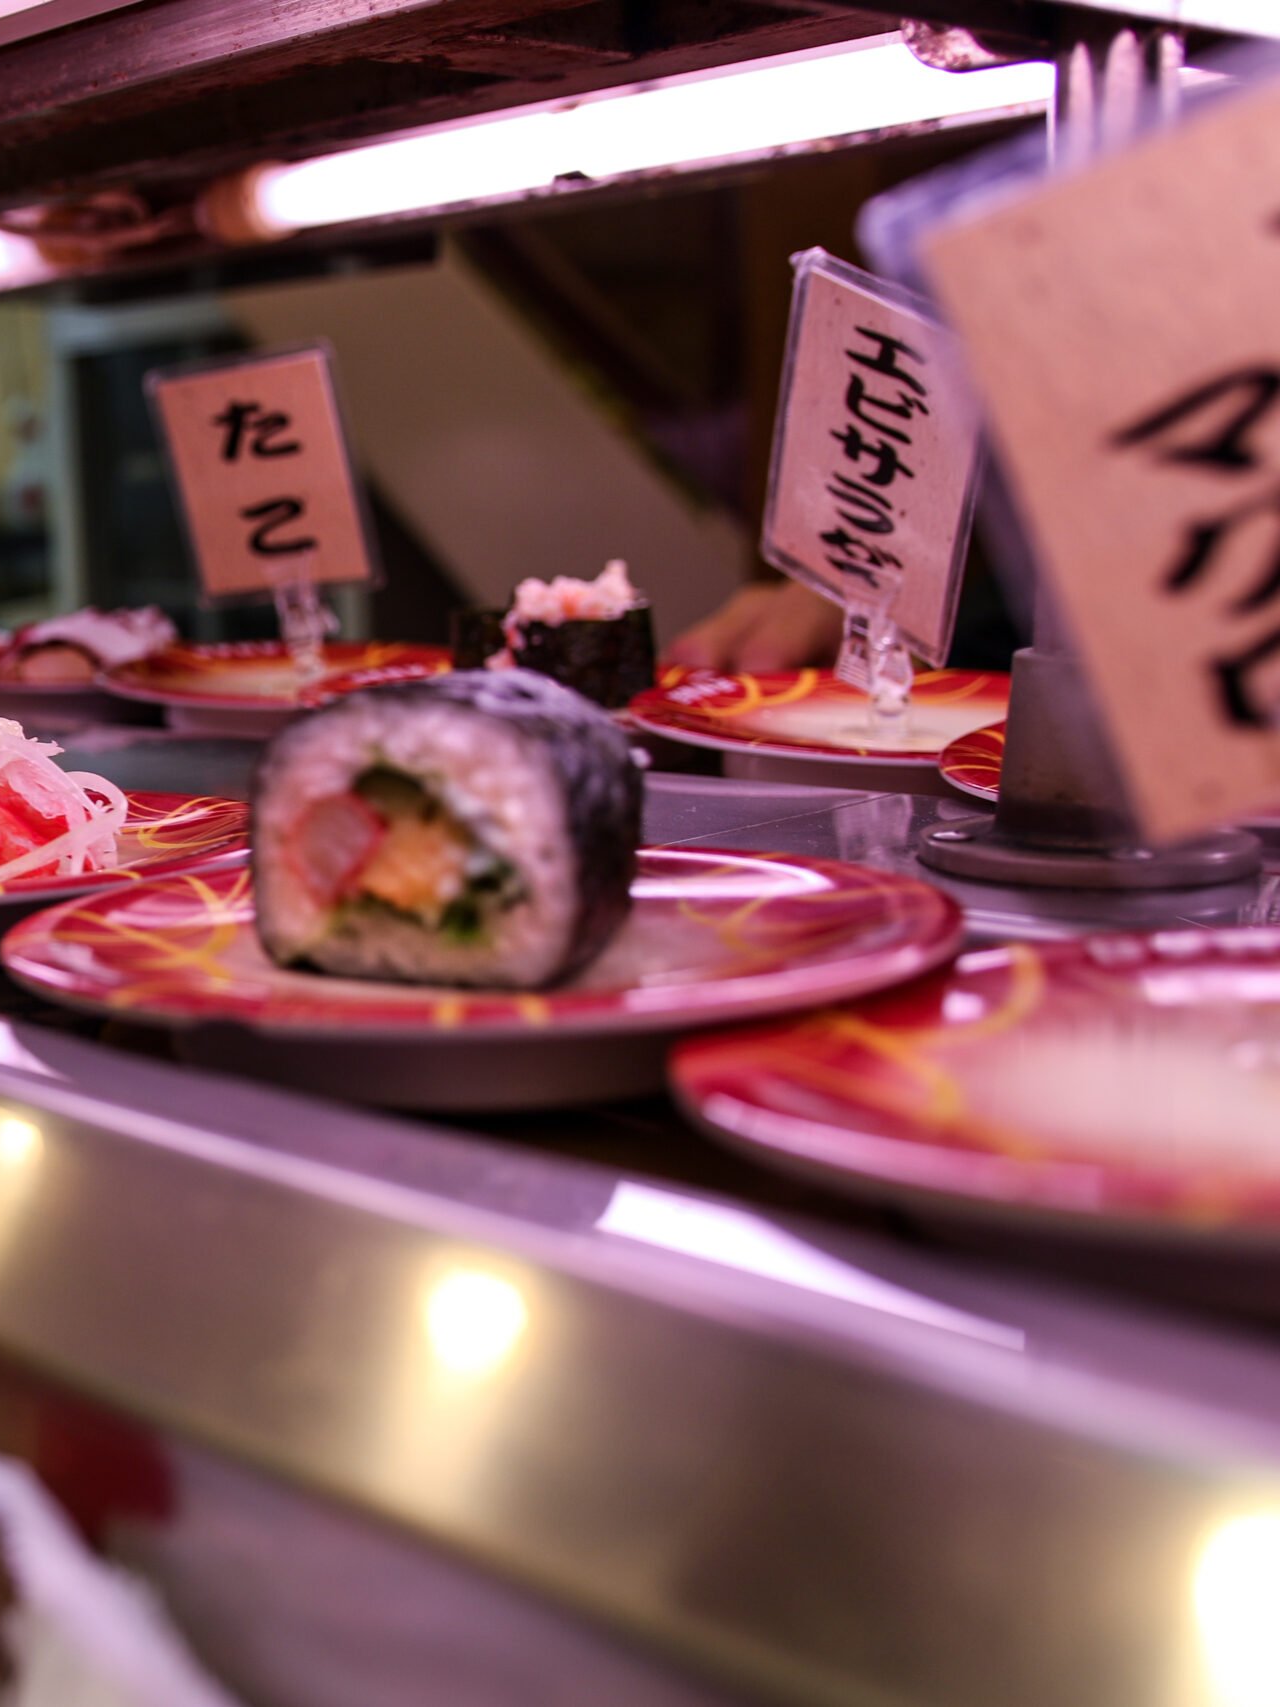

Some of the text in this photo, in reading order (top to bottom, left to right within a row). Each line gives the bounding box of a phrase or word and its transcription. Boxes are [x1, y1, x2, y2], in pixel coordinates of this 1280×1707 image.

[210, 399, 319, 558] たこ
[819, 325, 929, 588] エビサラダ
